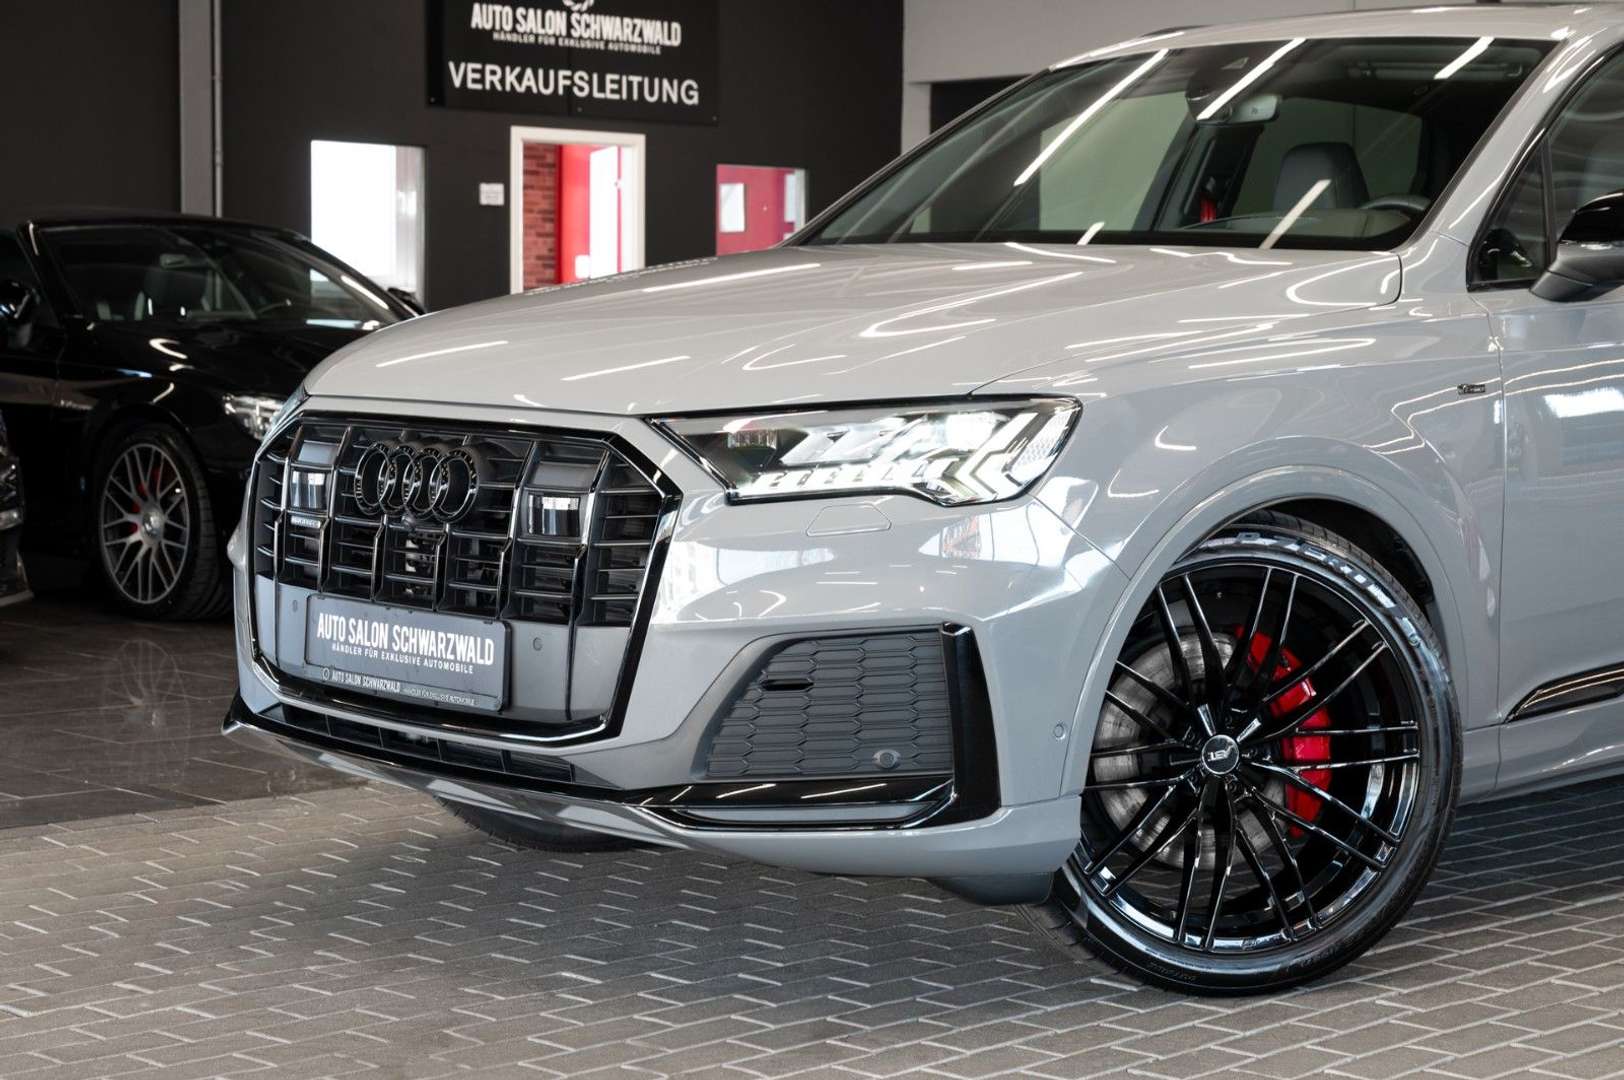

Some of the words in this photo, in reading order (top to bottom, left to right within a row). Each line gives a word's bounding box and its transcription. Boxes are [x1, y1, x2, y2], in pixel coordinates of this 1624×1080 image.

[471, 2, 513, 31] AUTO
[515, 7, 568, 37] SALON
[570, 13, 682, 47] SCHWARZWALD
[493, 31, 536, 44] HÄNDLER
[538, 35, 556, 46] FÜR
[558, 37, 605, 50] EXKLUSIVE
[608, 41, 661, 55] AUTOMOBILE
[448, 61, 699, 105] VERKAUFSLEITUNG
[317, 613, 346, 641] AUTO
[348, 618, 388, 649] SALON
[392, 624, 494, 665] SCHWARZWALD
[332, 643, 362, 656] HÄNDLER
[365, 647, 378, 659] FÜR
[381, 653, 421, 666] EXKLUSIVE
[423, 658, 473, 674] AUTOMOBILE
[362, 676, 400, 693] SCHWARZWALD
